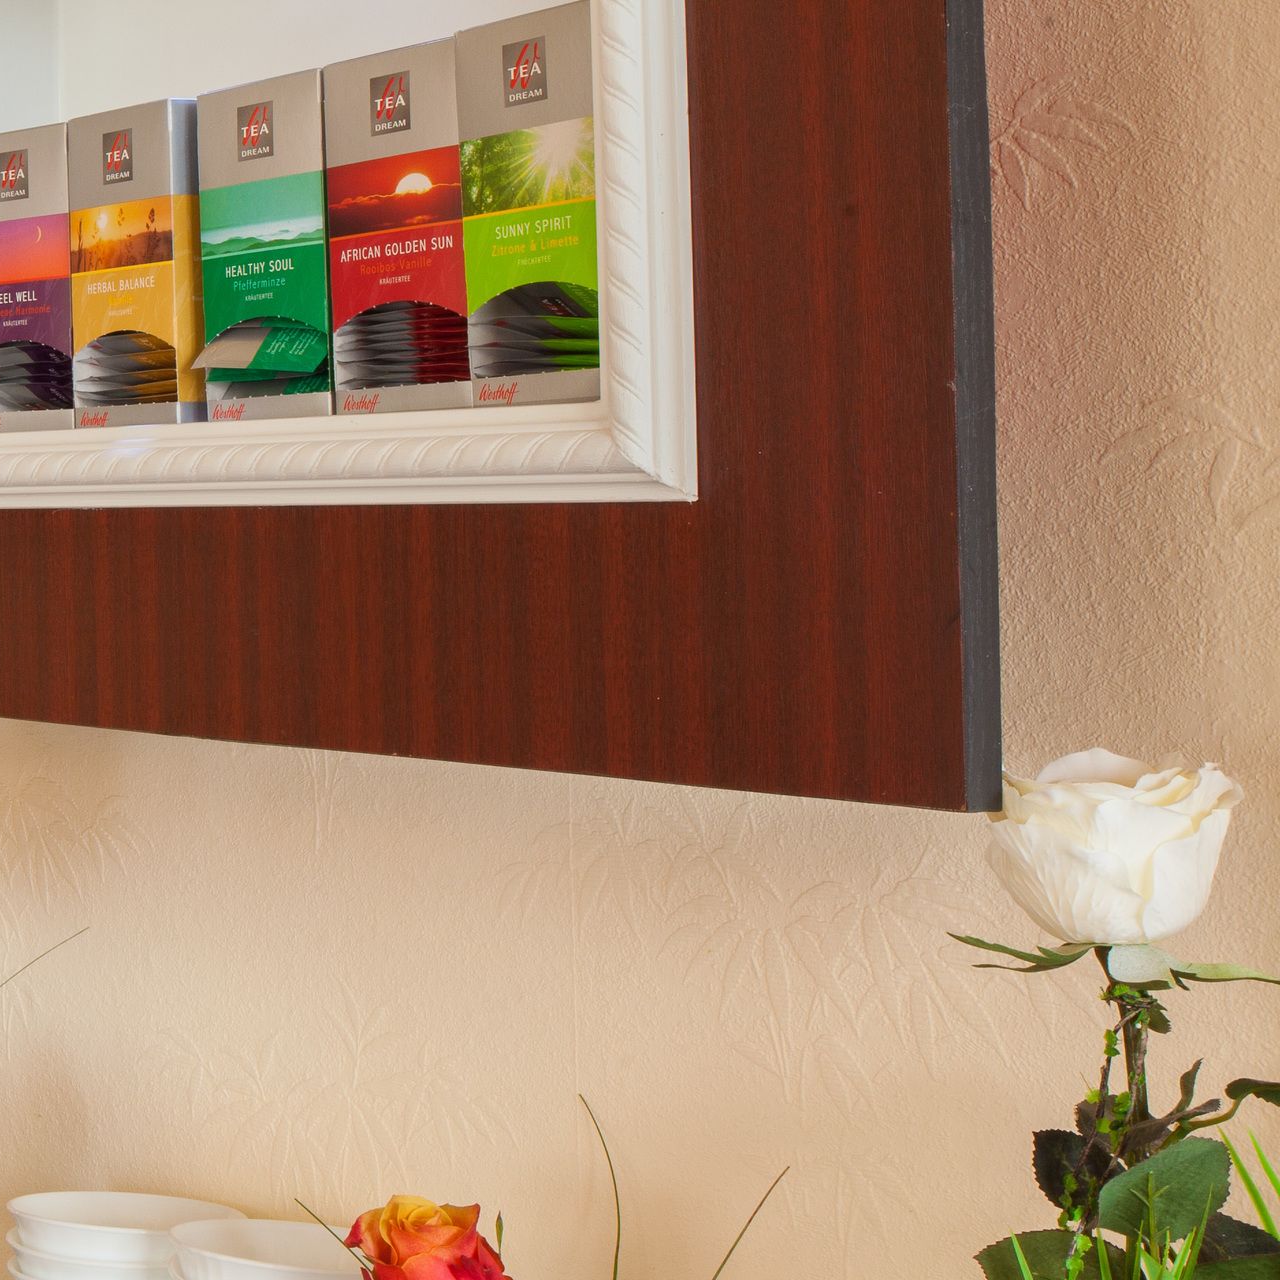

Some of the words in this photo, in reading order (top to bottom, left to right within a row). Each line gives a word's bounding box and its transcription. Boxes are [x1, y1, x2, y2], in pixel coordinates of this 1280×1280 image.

[508, 62, 542, 80] TEA
[374, 94, 406, 111] TEA
[508, 88, 543, 102] DREAM
[241, 123, 269, 138] TEA
[374, 119, 407, 132] DREAM
[106, 149, 130, 163] TEA
[241, 146, 270, 158] DREAM
[0, 168, 25, 181] TEA
[106, 171, 130, 181] DREAM
[1, 189, 26, 199] DREAM
[495, 223, 530, 240] SUNNY
[535, 215, 572, 234] SPIRIT
[340, 244, 381, 263] AFRICAN
[384, 239, 427, 256] GOLDEN
[431, 235, 454, 250] SUN
[491, 242, 525, 257] Zitrone
[540, 235, 580, 251] Limette
[225, 262, 266, 279] HEALTHY
[269, 258, 295, 272] SOUL
[360, 261, 396, 277] Rooibos
[399, 255, 432, 271] Vanille
[87, 280, 117, 295] HERBAL
[119, 275, 156, 291] BALANCE
[233, 278, 286, 292] Pfefferminze
[379, 275, 411, 286] KRÄUTERTEE
[15, 290, 37, 303] WELL
[479, 383, 519, 405] Westhoff
[343, 394, 380, 413] Westhoff
[80, 410, 109, 428] Westhoff
[213, 404, 246, 421] Westhoff
